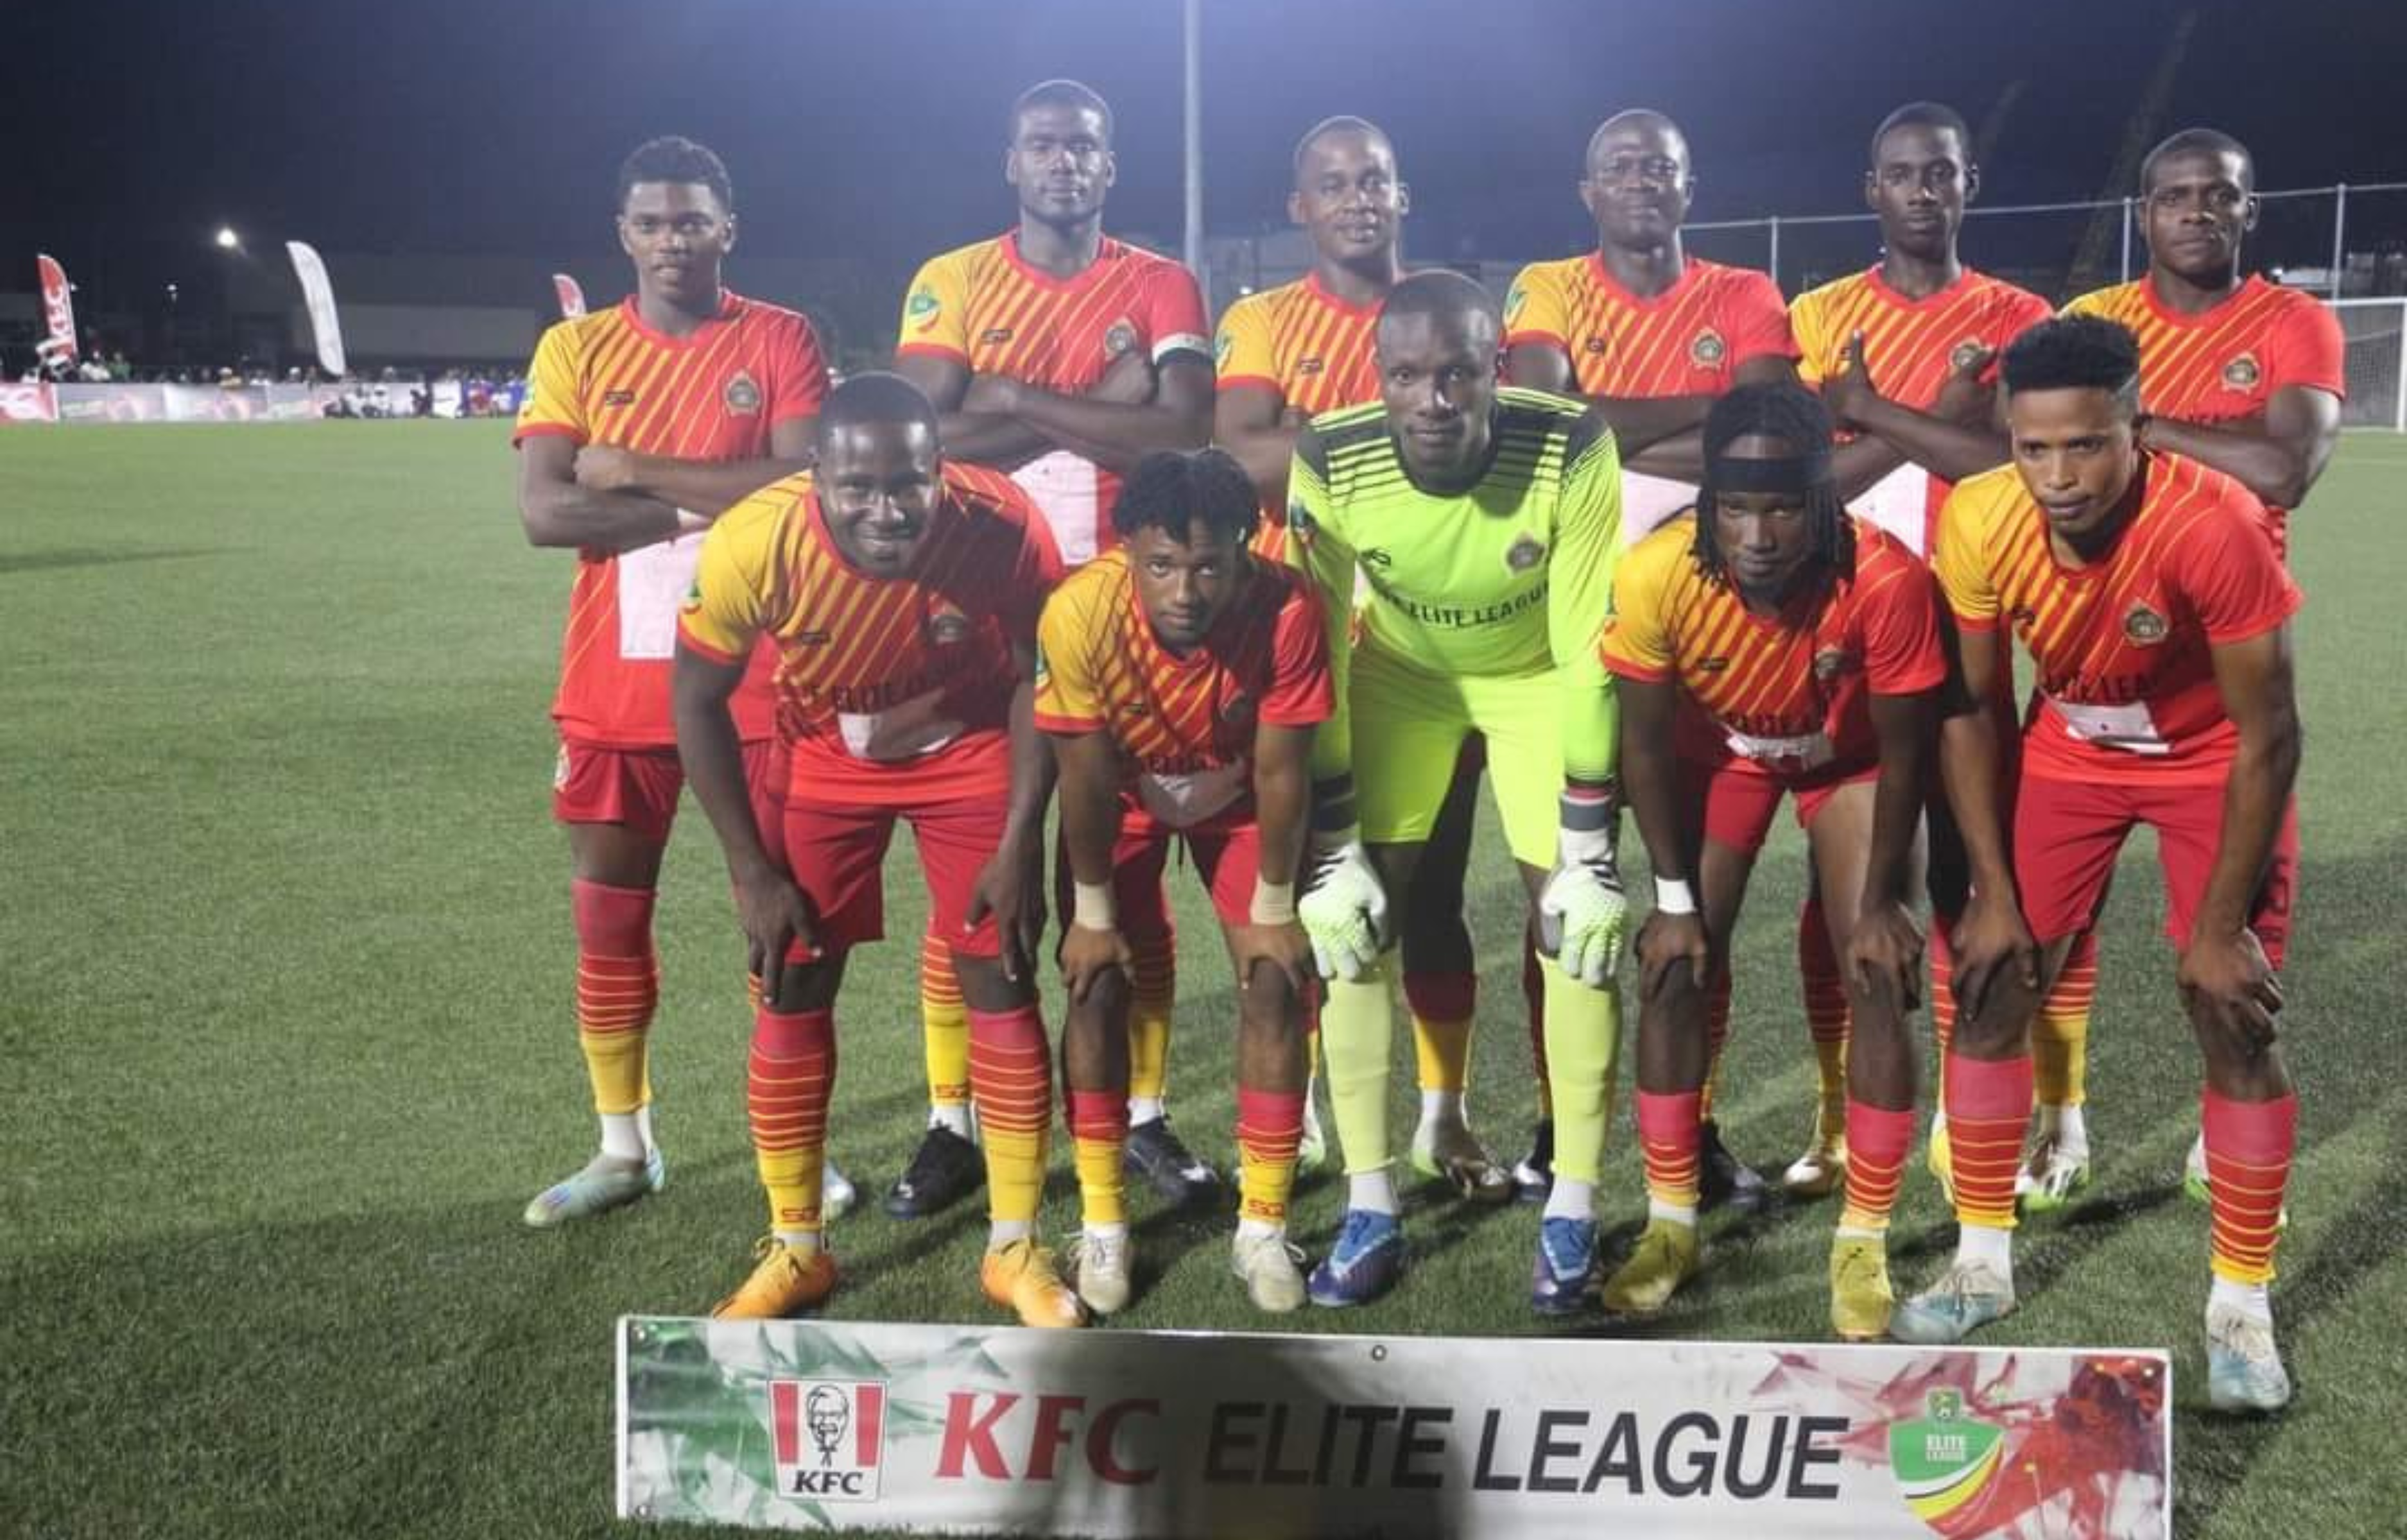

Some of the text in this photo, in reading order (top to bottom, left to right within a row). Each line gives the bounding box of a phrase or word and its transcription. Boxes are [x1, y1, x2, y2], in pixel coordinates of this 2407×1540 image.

[1410, 600, 1471, 628] ELITE
[935, 1390, 1849, 1500] KFC ELITE LEAGUE
[793, 1470, 863, 1496] KFC
